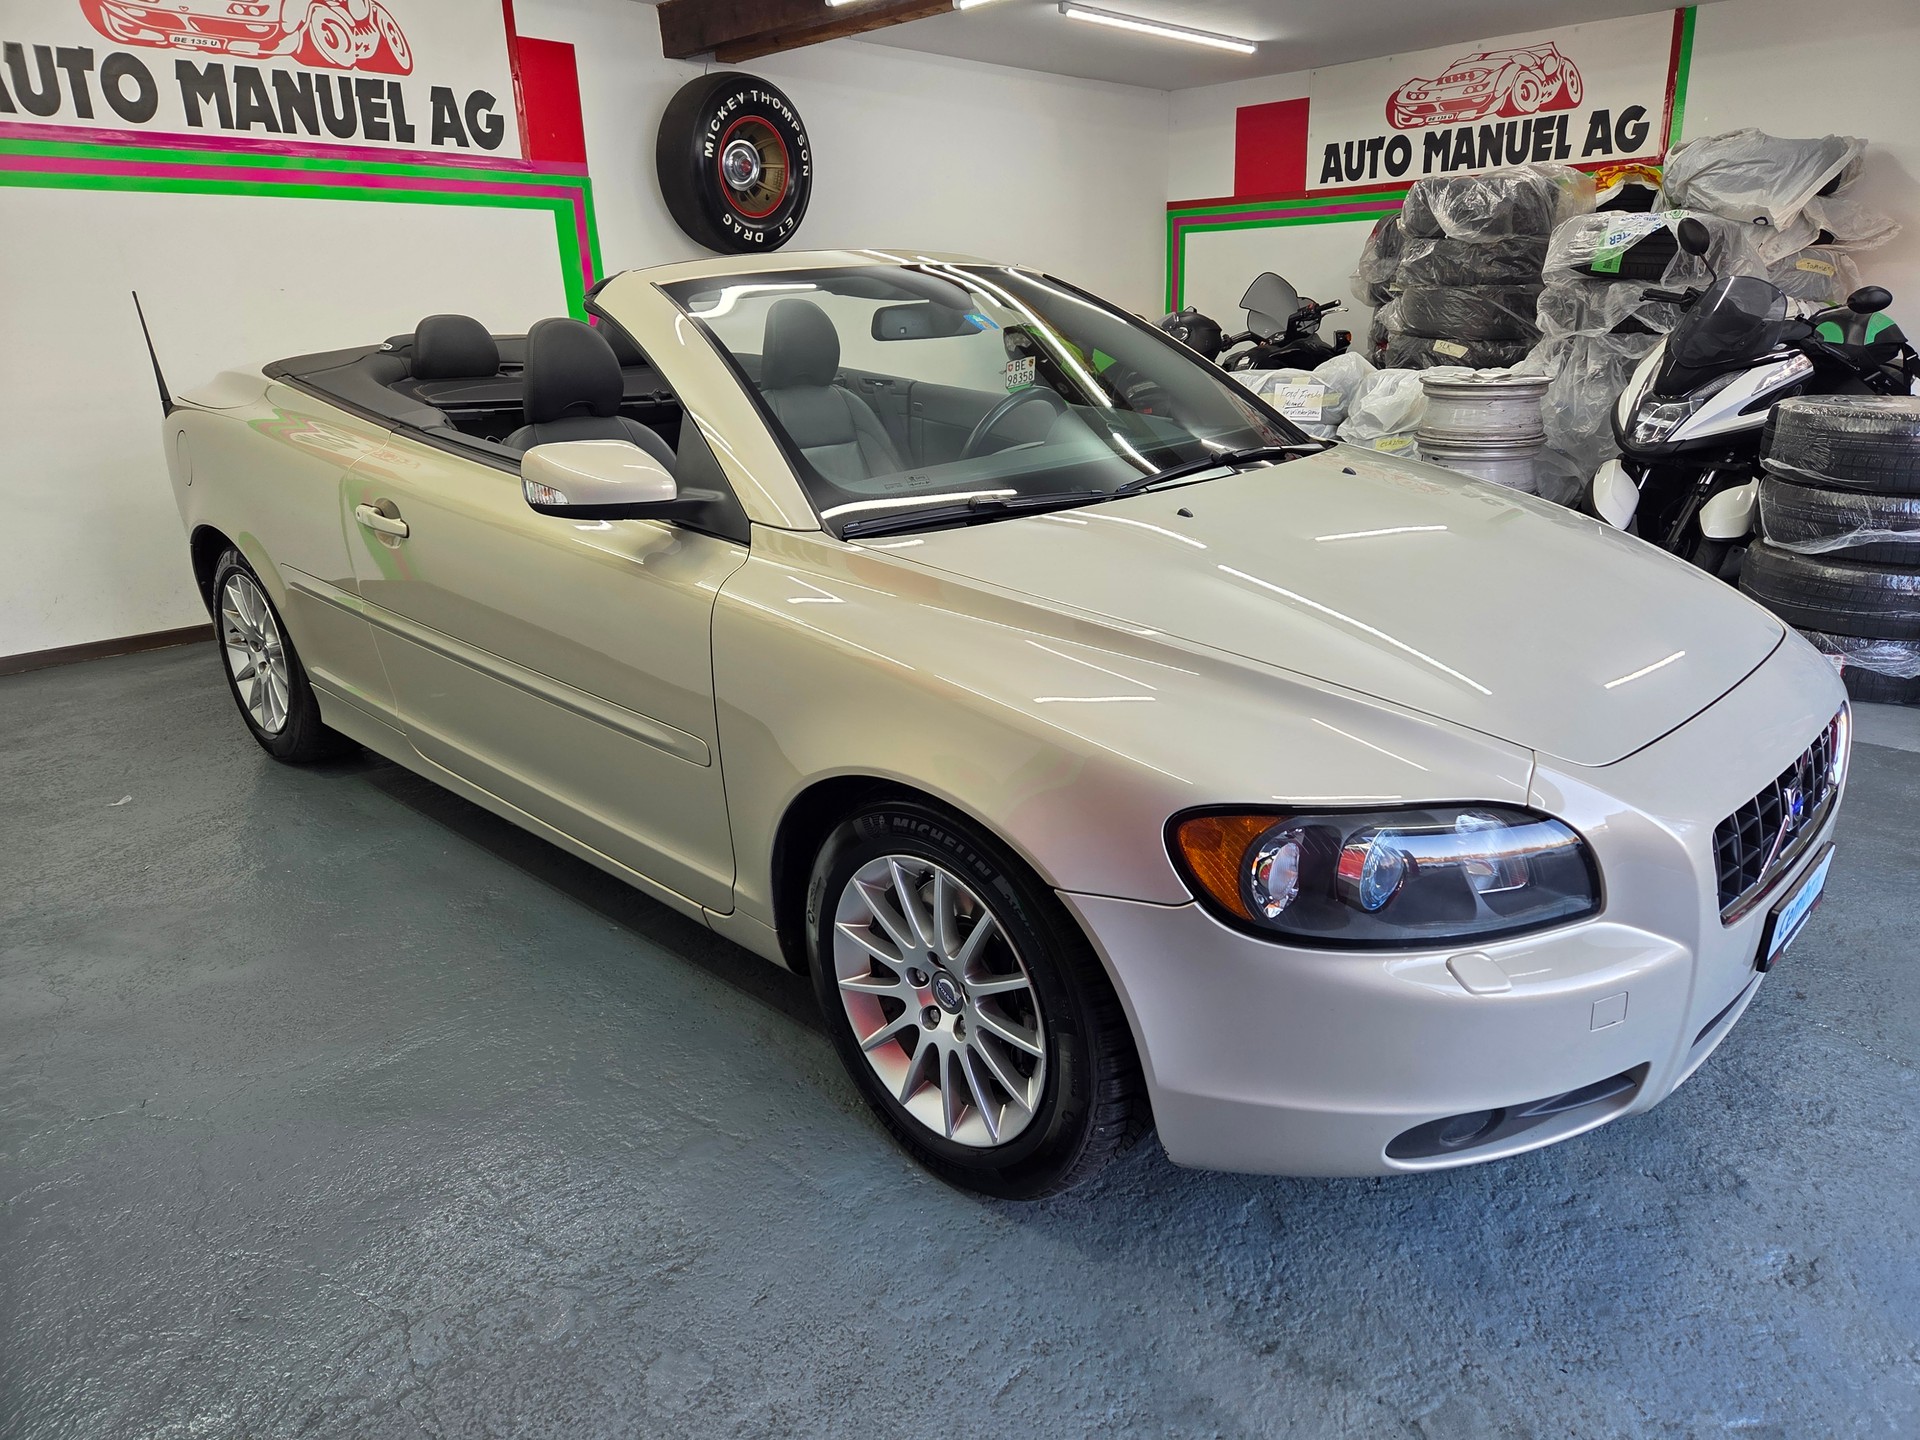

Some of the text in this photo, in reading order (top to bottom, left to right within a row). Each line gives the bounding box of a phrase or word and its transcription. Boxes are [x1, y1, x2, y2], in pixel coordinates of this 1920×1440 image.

[175, 59, 415, 143] MANUEL
[430, 86, 505, 150] AG
[704, 90, 809, 177] MICKEY THOMPSON
[1319, 105, 1650, 184] AUTO MANUEL AG
[722, 213, 794, 242] ET DRAG
[1609, 232, 1631, 246] TER
[1007, 371, 1034, 386] 98358
[1015, 360, 1026, 371] BE
[892, 817, 992, 877] MICHELIN
